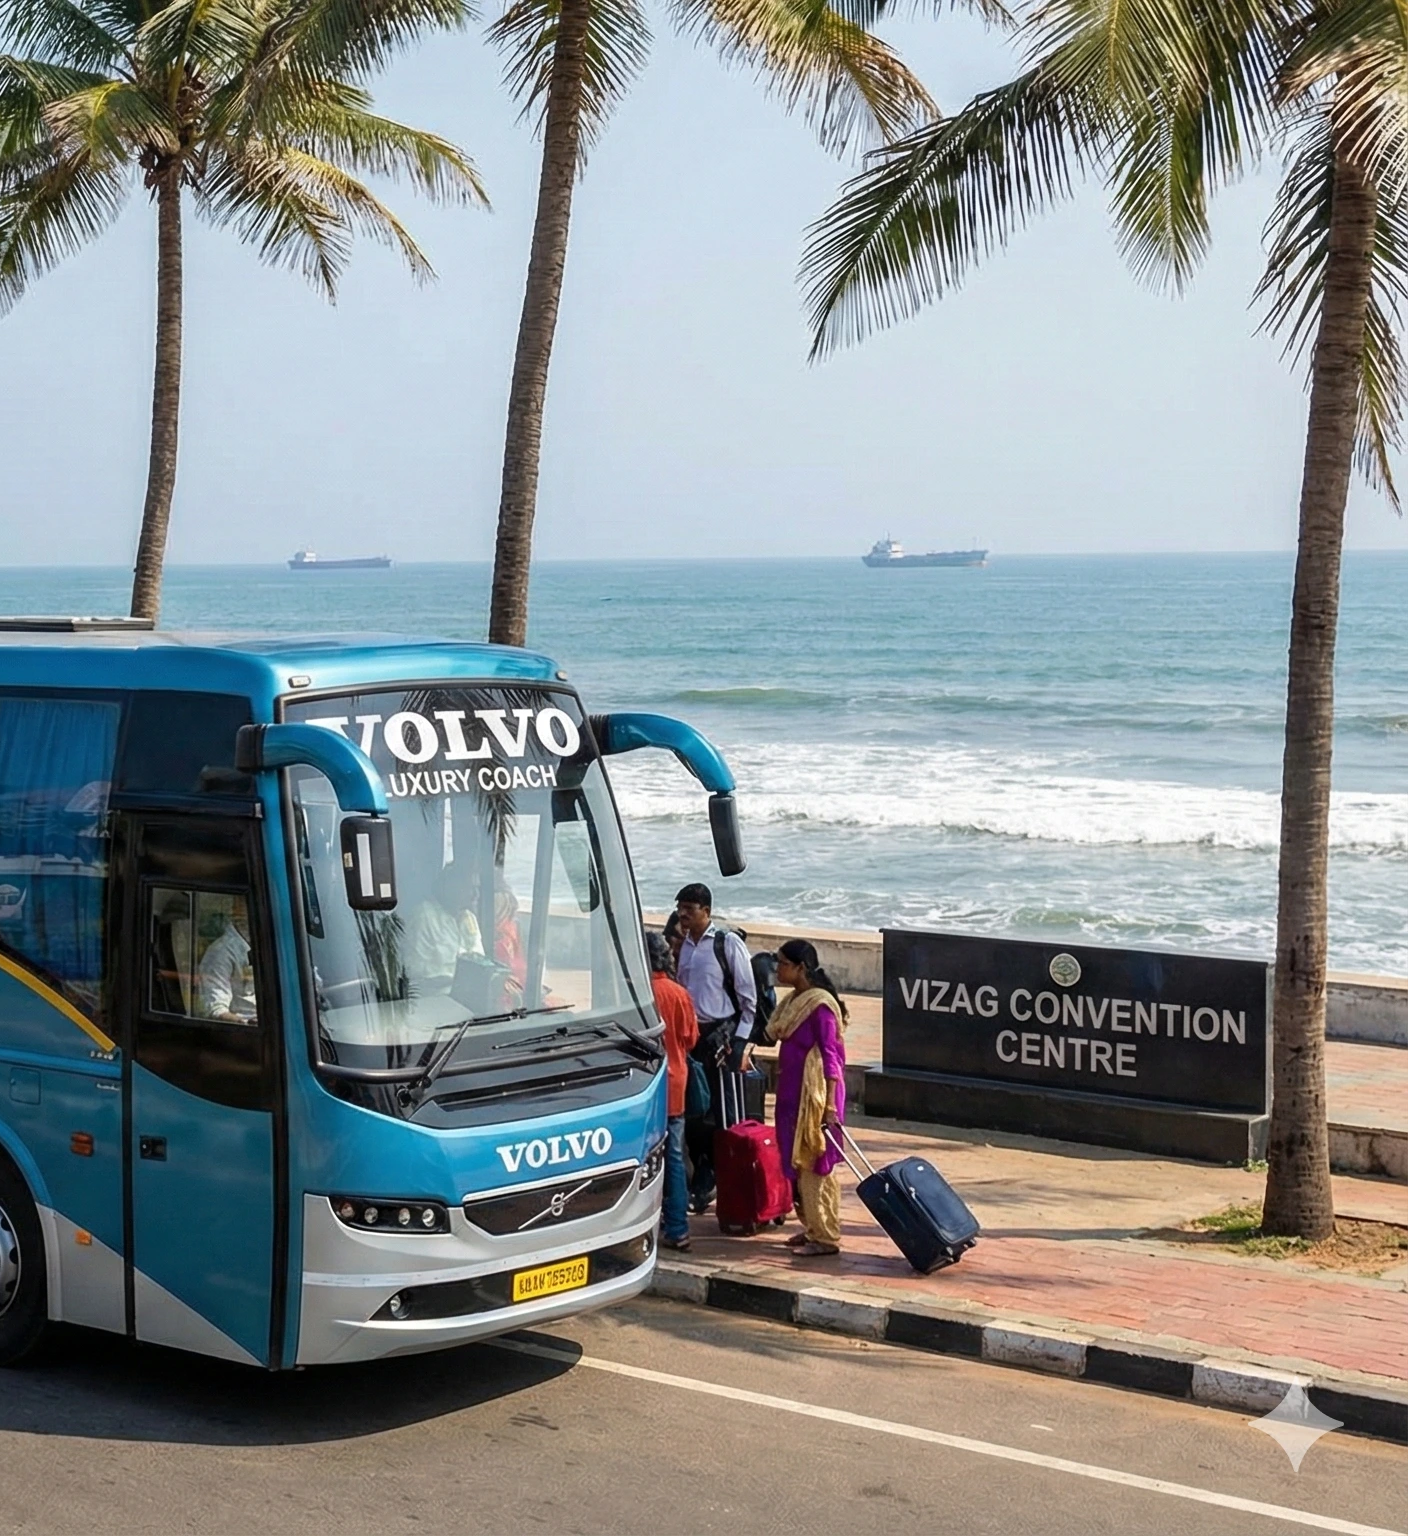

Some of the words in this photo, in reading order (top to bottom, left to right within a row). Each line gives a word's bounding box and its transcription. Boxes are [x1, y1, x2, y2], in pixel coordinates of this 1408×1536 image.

[385, 769, 470, 797] UXURY
[478, 765, 557, 791] COACH
[898, 977, 999, 1017] VIZAG
[1010, 988, 1246, 1044] CONVENTION
[996, 1030, 1137, 1077] CENTRE
[496, 1127, 612, 1171] VOLVO
